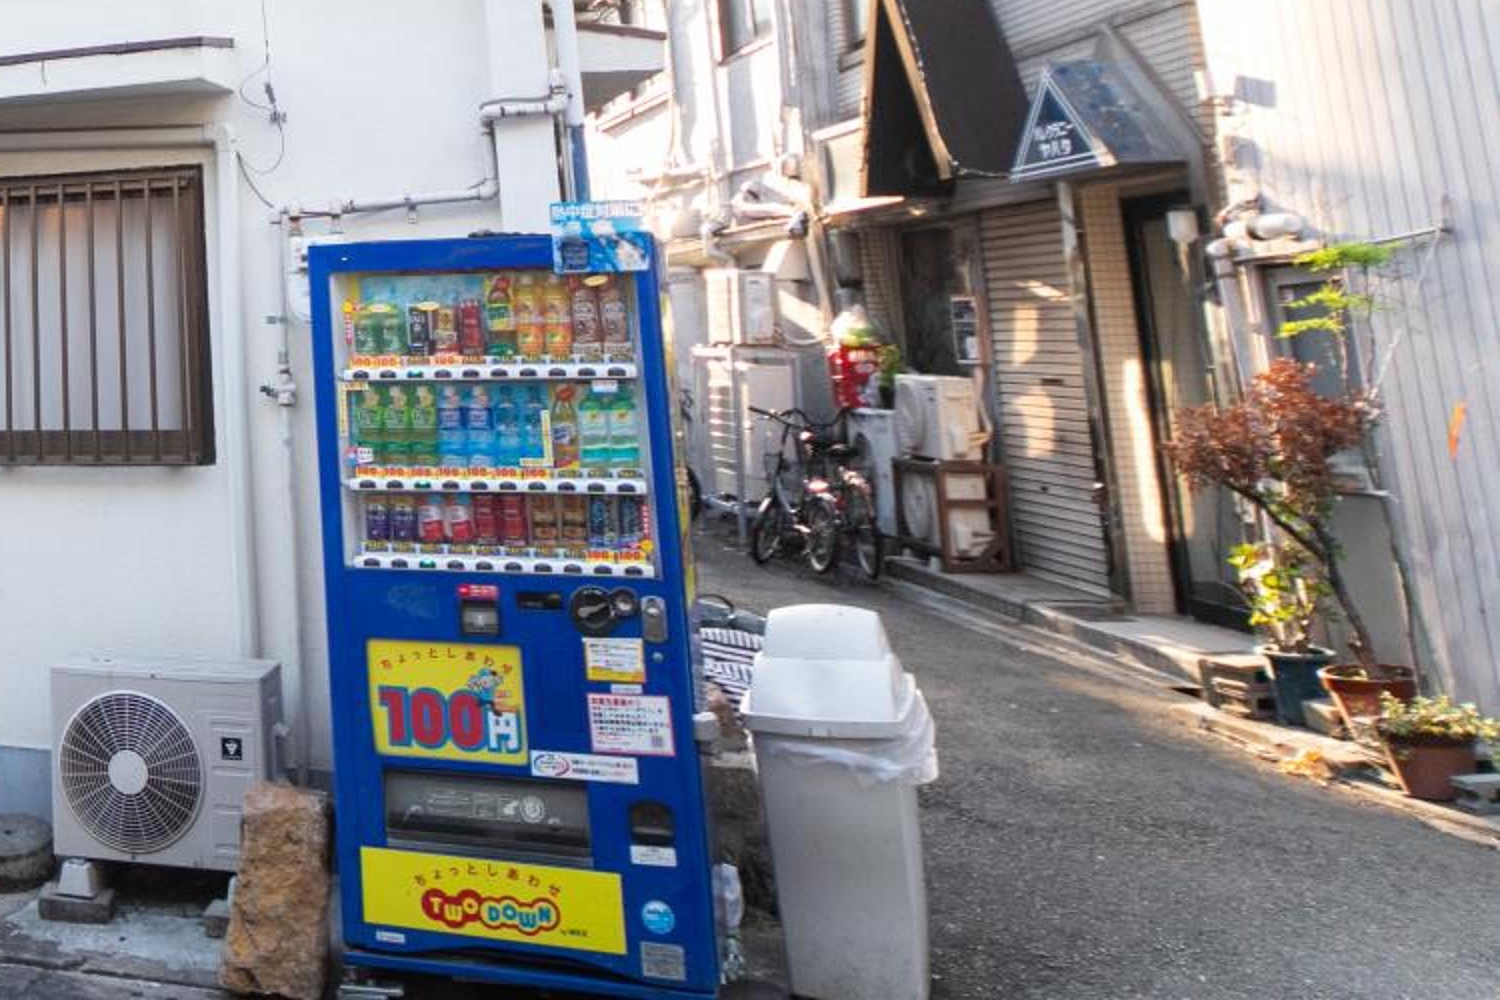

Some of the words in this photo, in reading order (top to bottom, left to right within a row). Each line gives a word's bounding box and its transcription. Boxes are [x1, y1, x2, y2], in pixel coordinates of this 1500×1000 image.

[380, 647, 513, 675] ちょっとしあわせ
[414, 864, 562, 897] ちょっとしあわせ
[429, 896, 480, 923] TWO
[486, 903, 552, 931] DOWN
